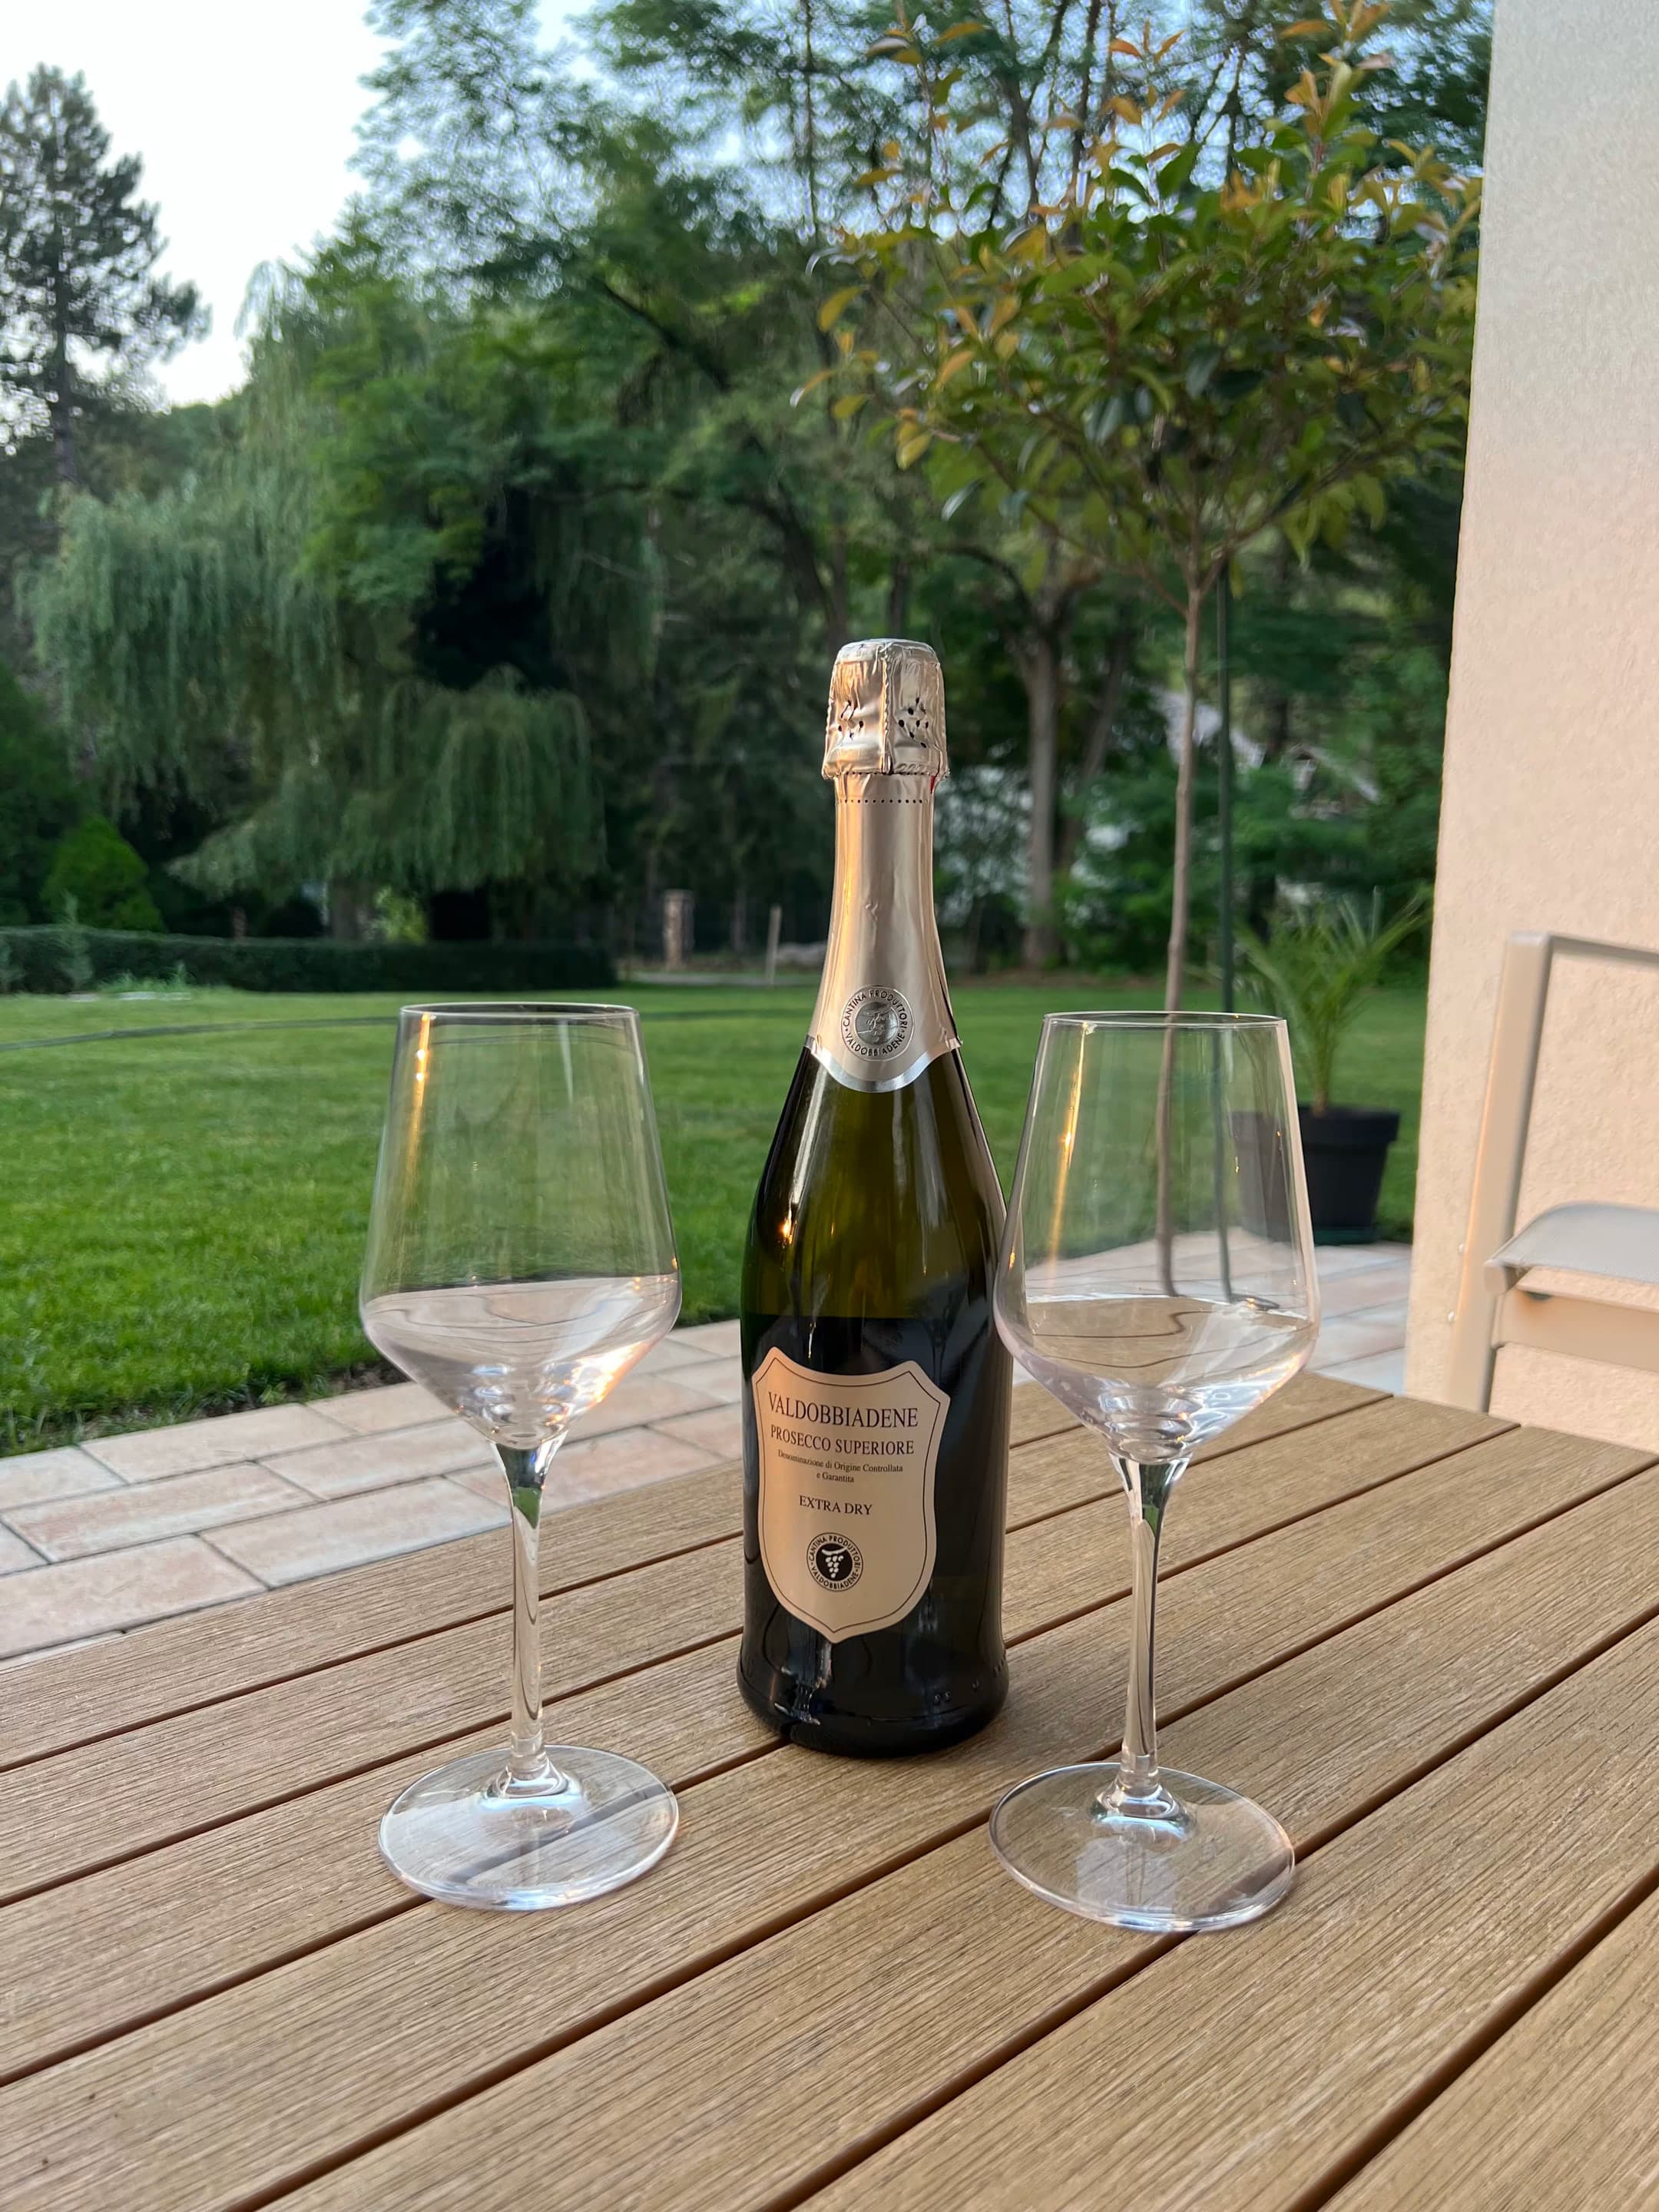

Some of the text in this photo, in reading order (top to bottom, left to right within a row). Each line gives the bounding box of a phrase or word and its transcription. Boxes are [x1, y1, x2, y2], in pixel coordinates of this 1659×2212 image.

[843, 989, 907, 1028] CANTINA PRODUTTORI
[846, 1033, 905, 1056] VALDOBBIADENE
[768, 1391, 919, 1428] VALDOBBIADENE
[770, 1424, 915, 1455] PROSECCO SUPERIORE
[778, 1449, 824, 1468] Denominazione
[834, 1462, 861, 1472] Origine
[863, 1463, 903, 1472] Controllata
[822, 1472, 855, 1483] Garantita
[800, 1495, 873, 1515] EXTRA DRY
[809, 1535, 861, 1569] CANTINA PRODUTTORI
[811, 1565, 859, 1589] VALDOBBIADENE
